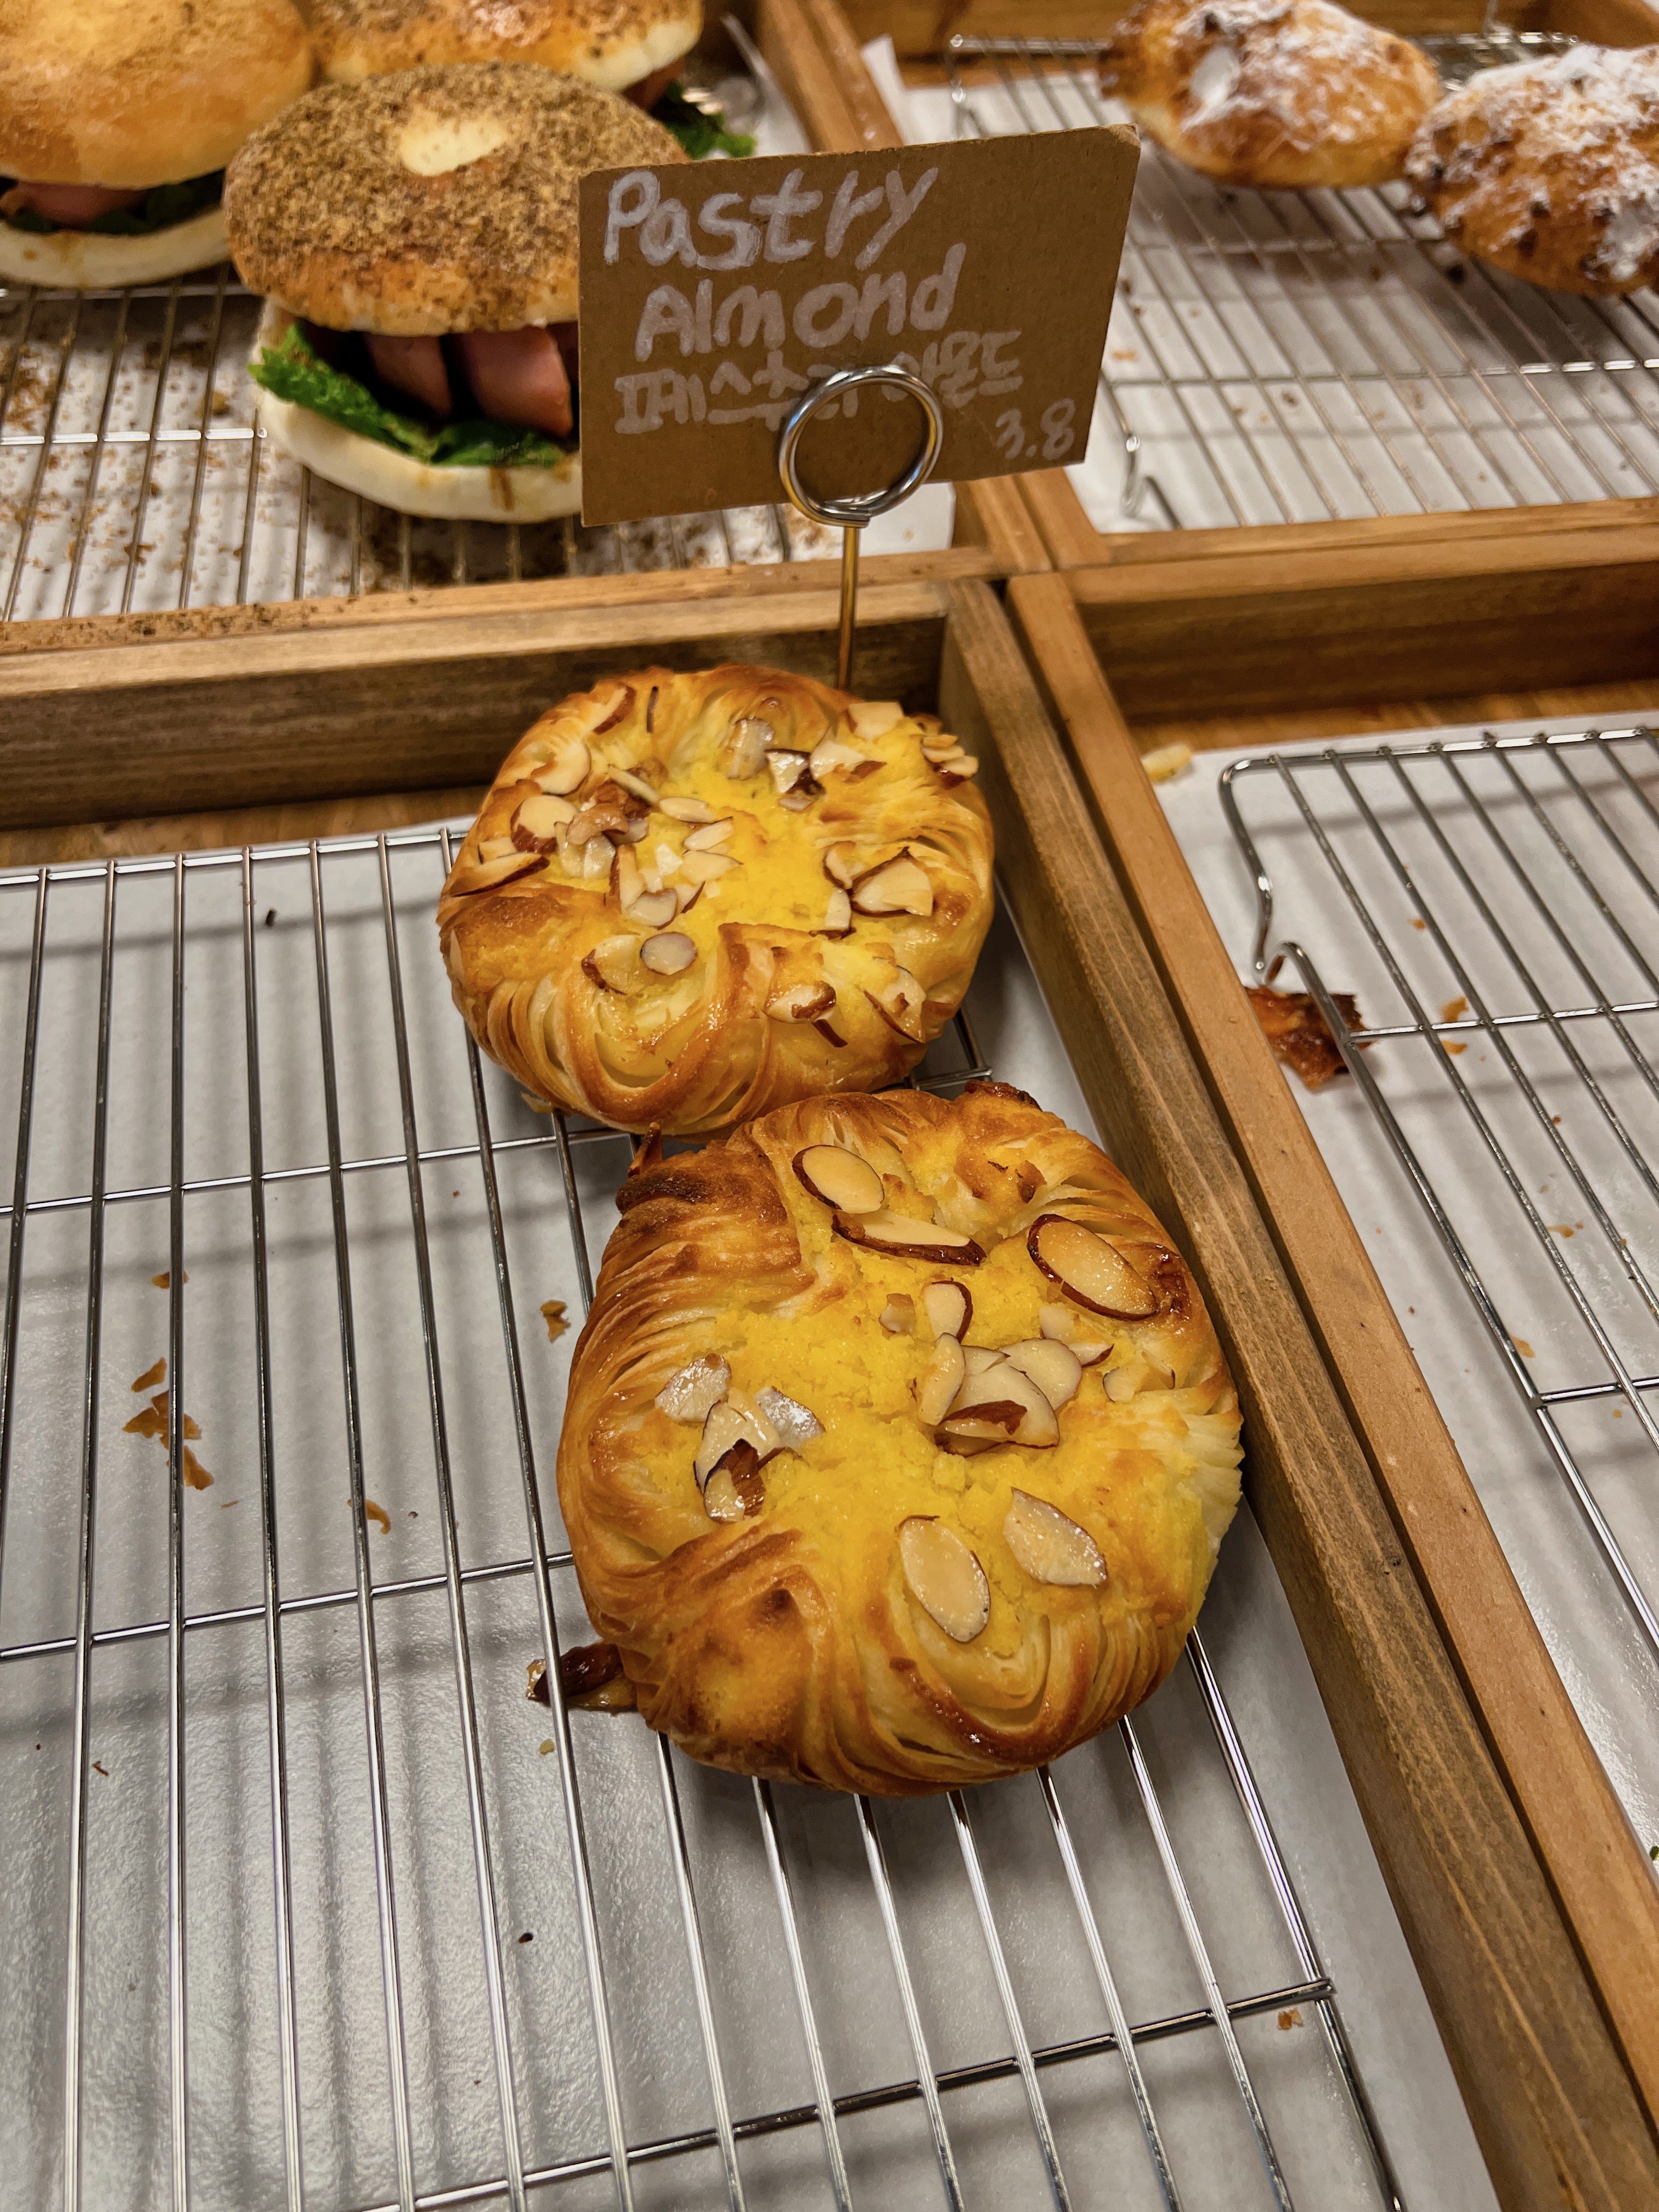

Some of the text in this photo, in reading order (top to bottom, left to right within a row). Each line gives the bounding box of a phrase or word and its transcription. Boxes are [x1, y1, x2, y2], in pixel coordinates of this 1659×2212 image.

[603, 167, 938, 270] Pastry
[635, 243, 966, 361] Almond
[995, 397, 1076, 460] 3.8
